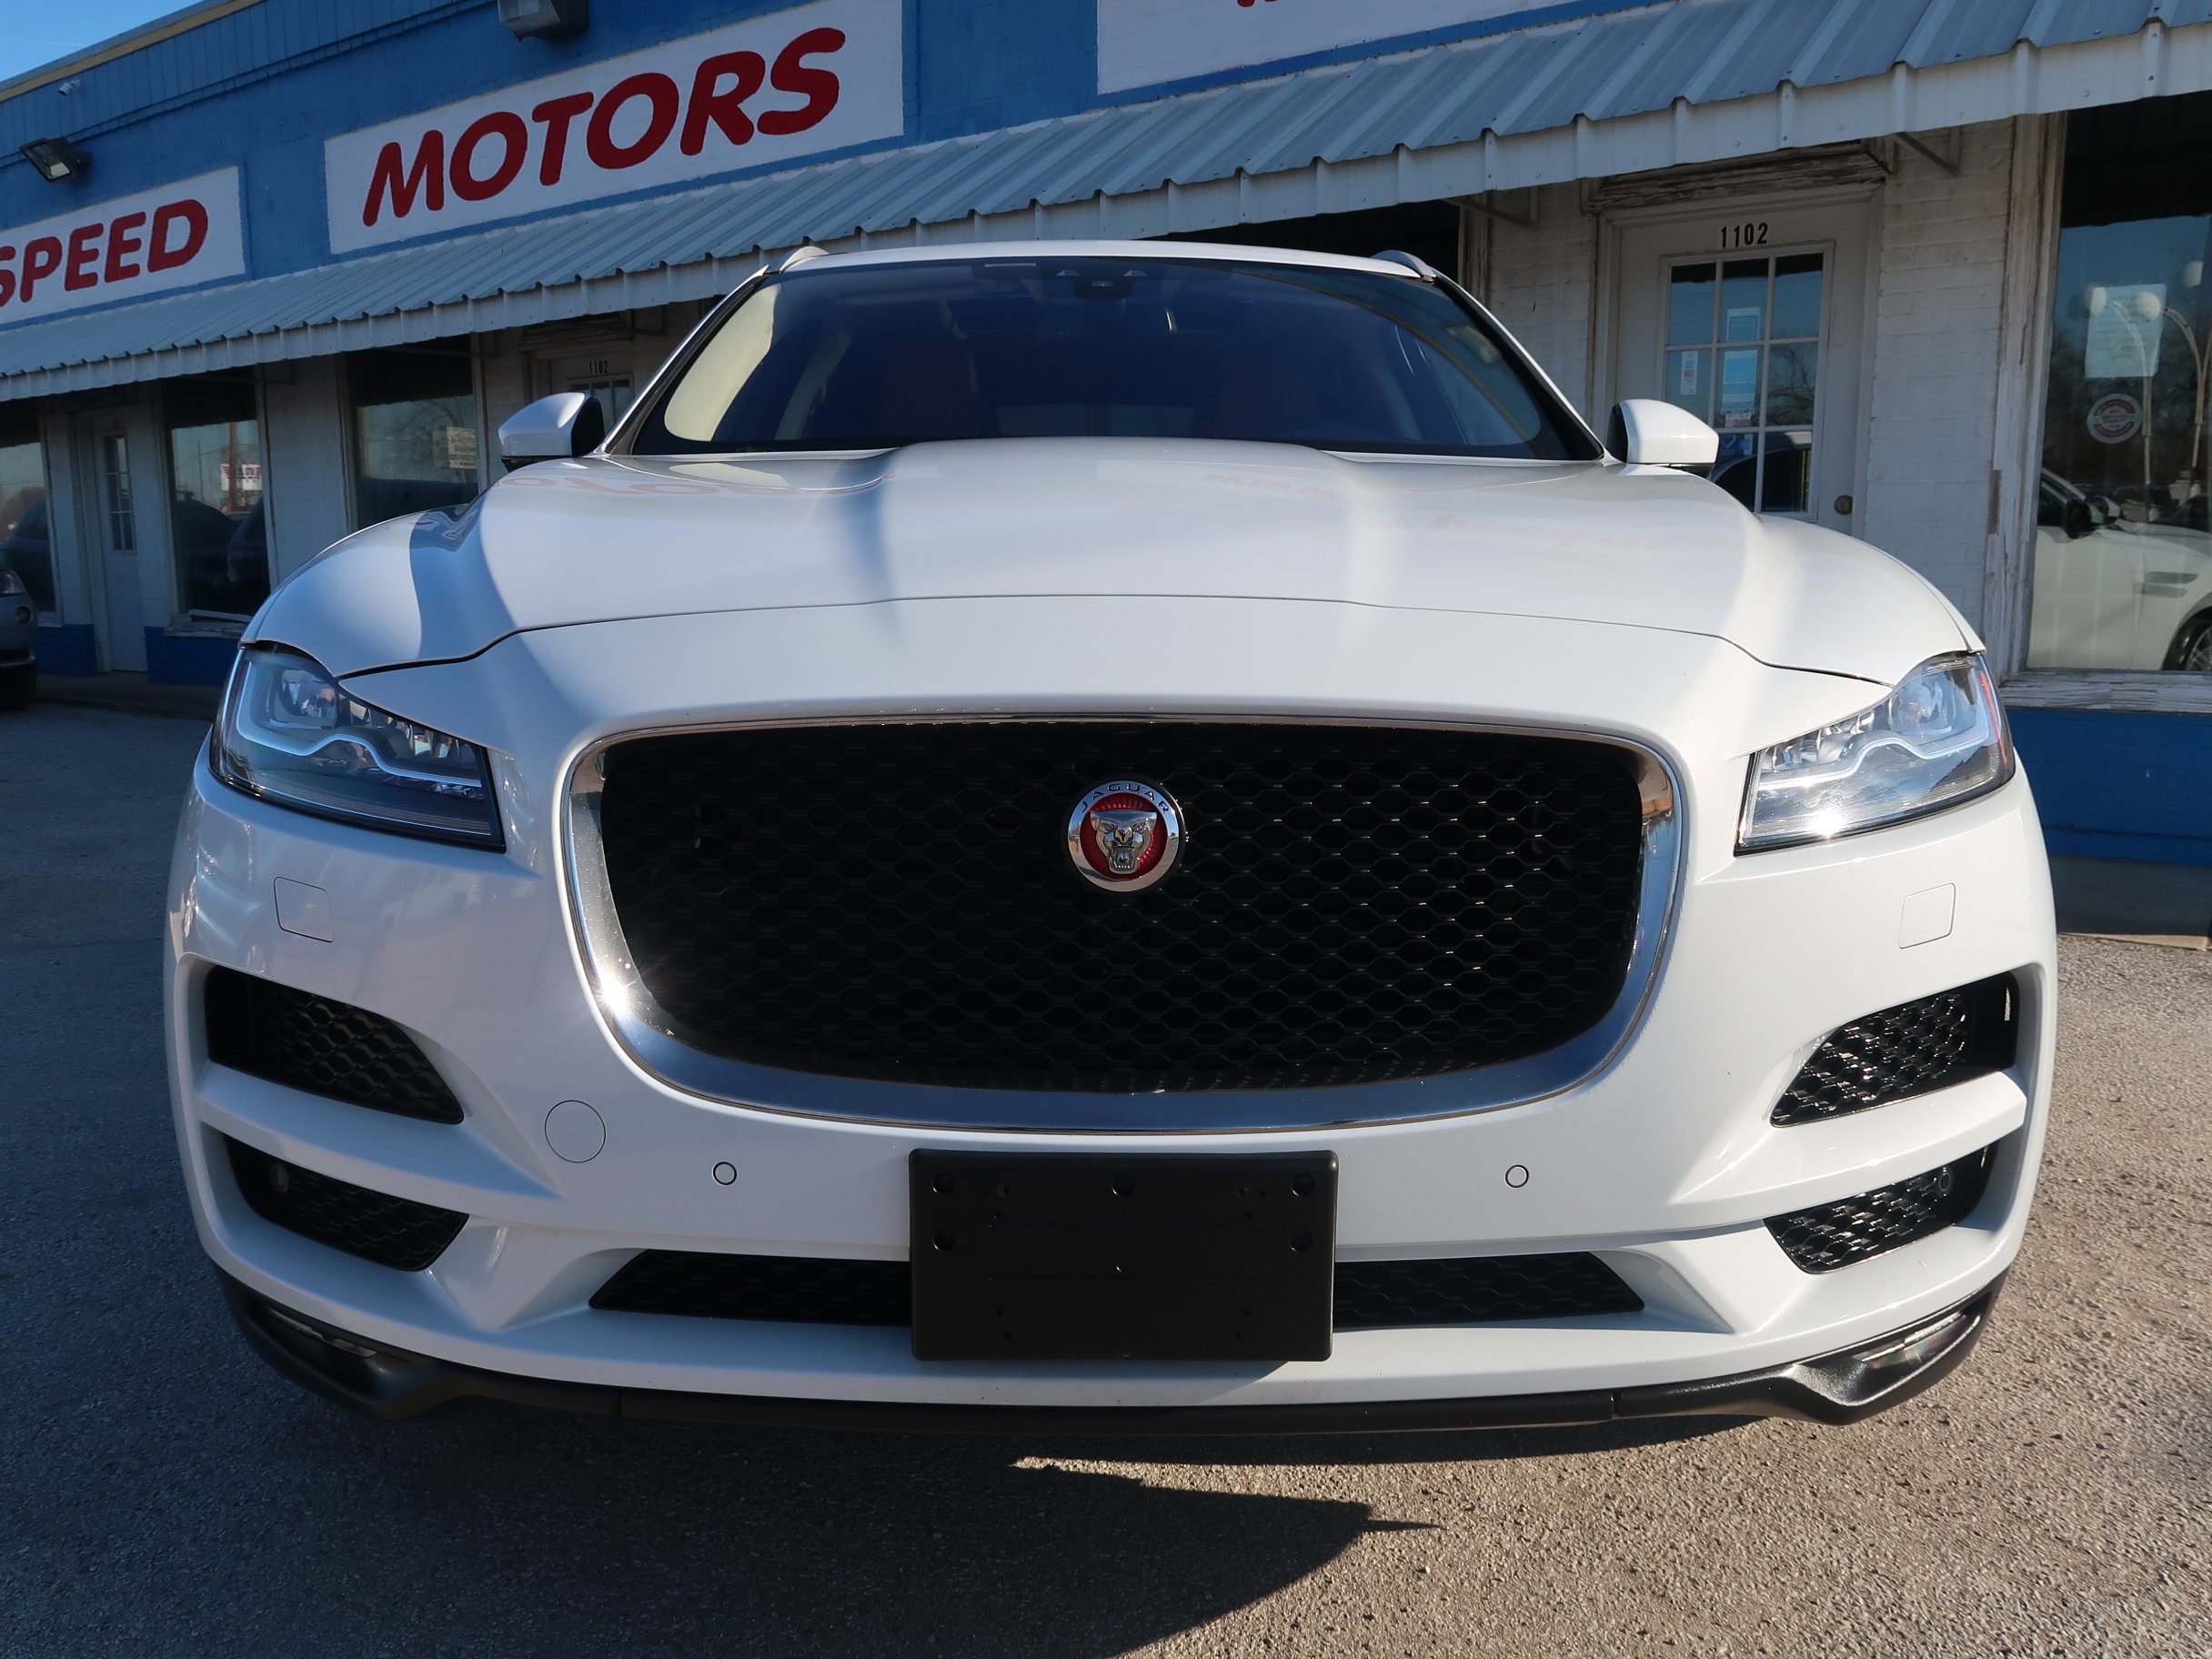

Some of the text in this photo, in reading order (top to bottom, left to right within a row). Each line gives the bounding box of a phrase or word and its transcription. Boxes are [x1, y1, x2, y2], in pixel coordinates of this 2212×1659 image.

[362, 26, 847, 227] MOTORS
[1720, 222, 1769, 248] 1102
[588, 359, 609, 375] 1102
[1081, 782, 1170, 814] JAGUAR
